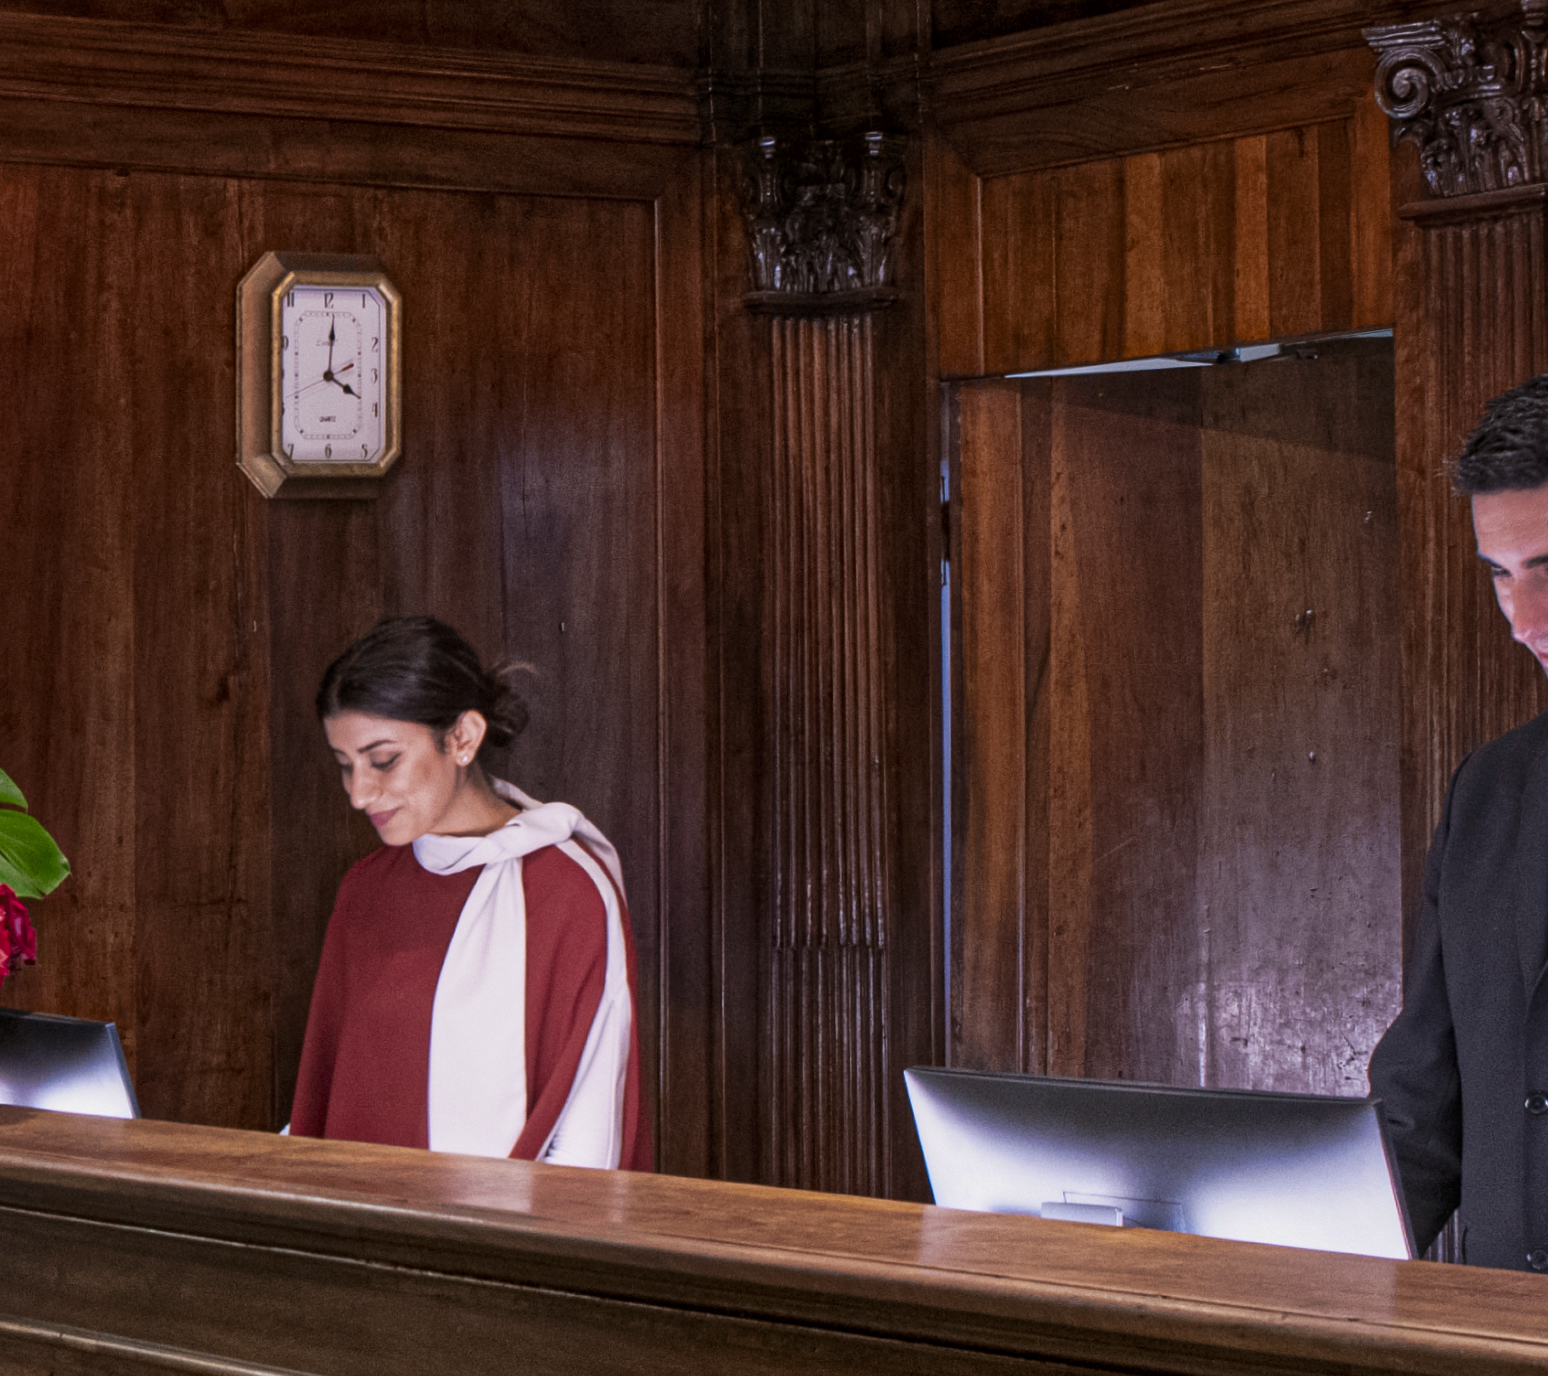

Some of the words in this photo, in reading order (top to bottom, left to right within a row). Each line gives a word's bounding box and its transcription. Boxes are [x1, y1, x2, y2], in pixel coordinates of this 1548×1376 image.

[324, 292, 334, 309] 12
[362, 293, 366, 309] 1
[371, 337, 379, 353] 2
[370, 368, 378, 384] 3
[371, 402, 378, 418] 4
[287, 443, 295, 459] 7
[325, 443, 332, 459] 6
[361, 443, 368, 459] 5
